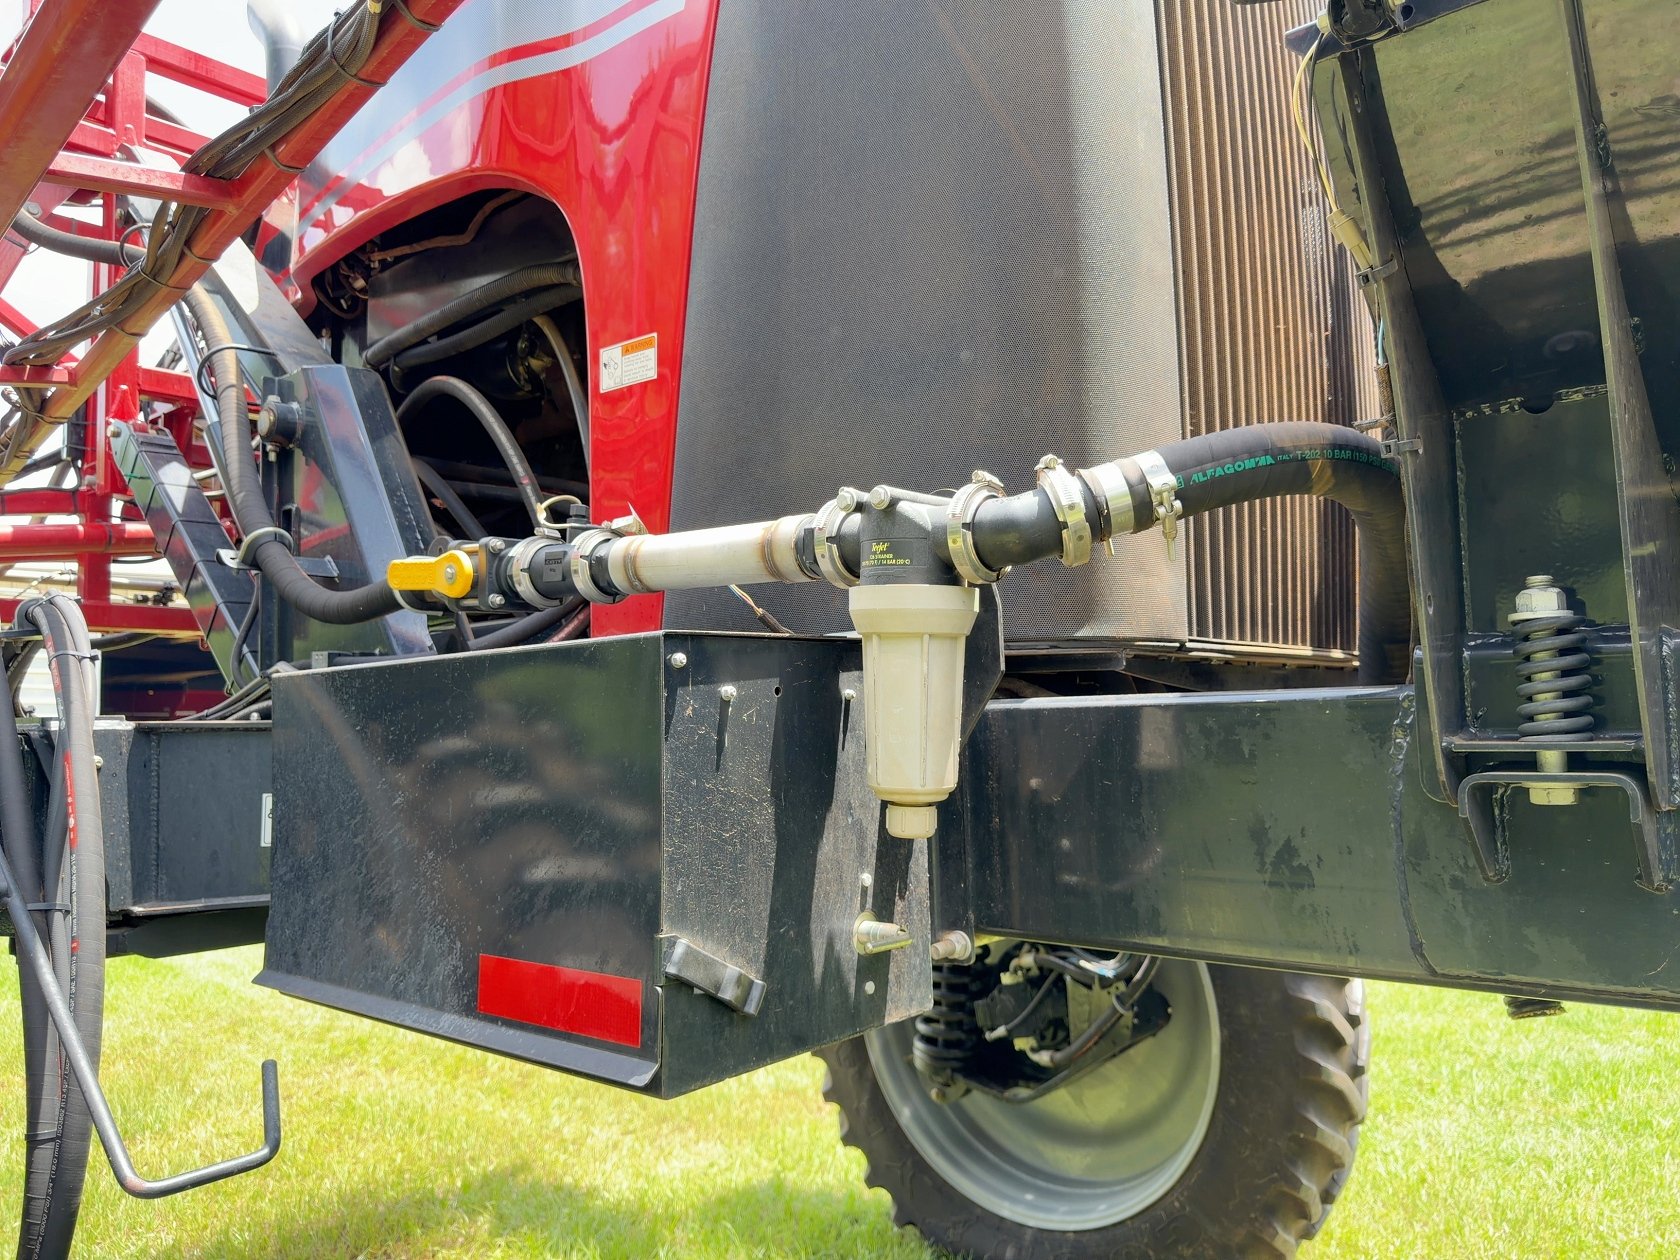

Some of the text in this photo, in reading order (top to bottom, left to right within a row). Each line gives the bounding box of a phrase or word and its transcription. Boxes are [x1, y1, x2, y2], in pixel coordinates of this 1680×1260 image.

[1190, 455, 1276, 485] ALFAGOMMA
[1277, 453, 1294, 461] ITALY
[1296, 450, 1321, 460] T-202
[1322, 449, 1333, 459] 10
[1334, 450, 1351, 459] BAR
